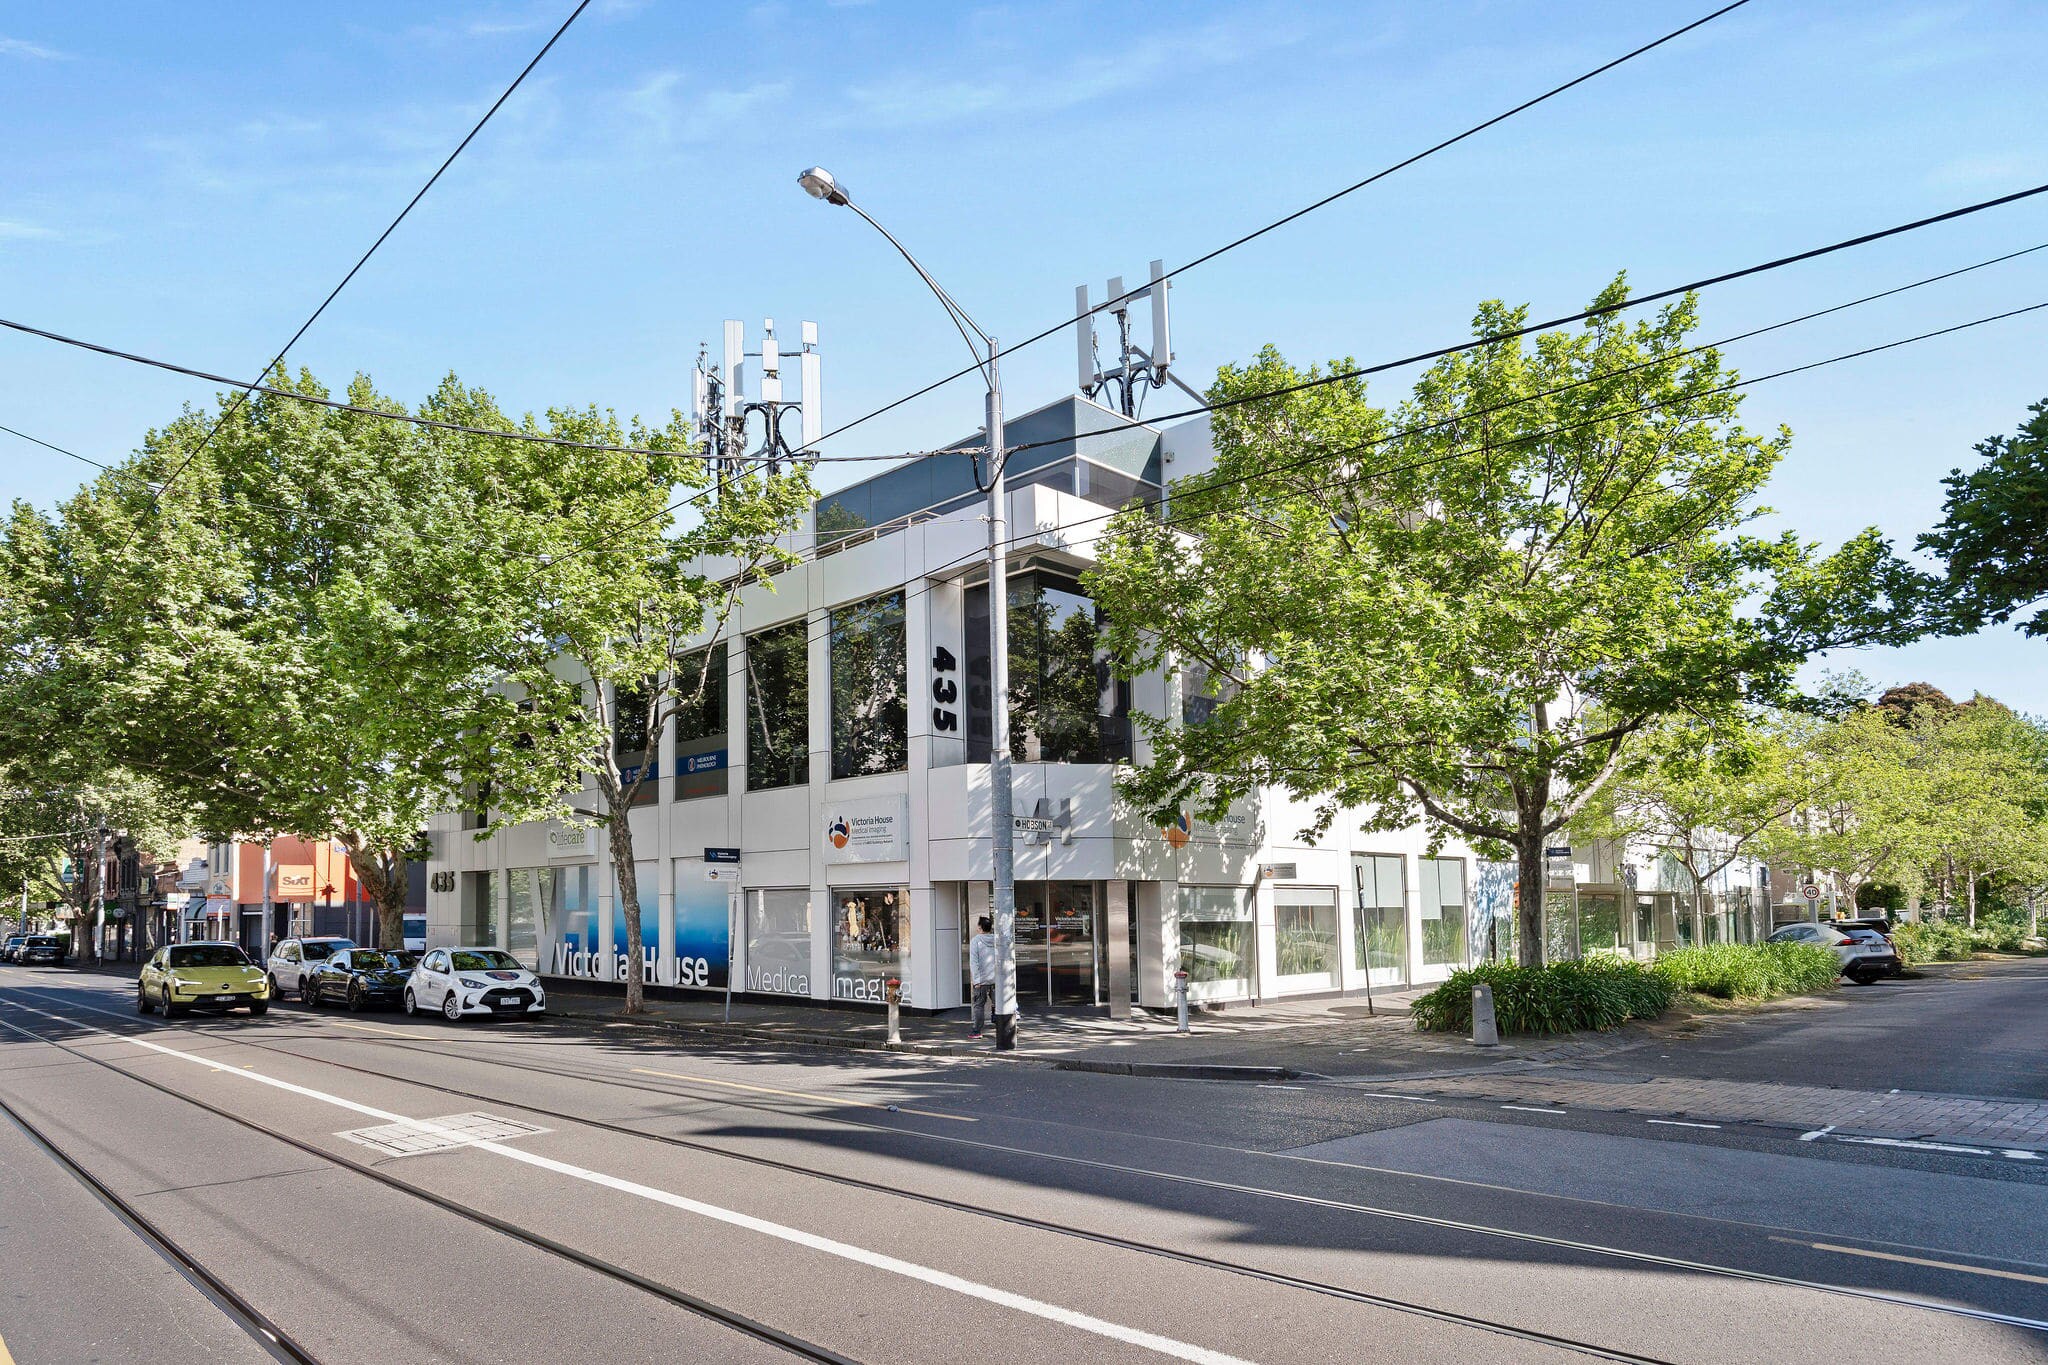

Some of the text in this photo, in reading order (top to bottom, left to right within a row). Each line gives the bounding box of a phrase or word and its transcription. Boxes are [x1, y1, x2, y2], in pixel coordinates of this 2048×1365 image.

[933, 646, 957, 731] 435
[851, 816, 894, 827] Victoria House
[851, 826, 887, 835] Medical Imaging
[1022, 820, 1047, 830] HOBSON
[431, 871, 455, 892] 435
[555, 942, 630, 981] Victoia
[832, 972, 912, 1004] Imagig
